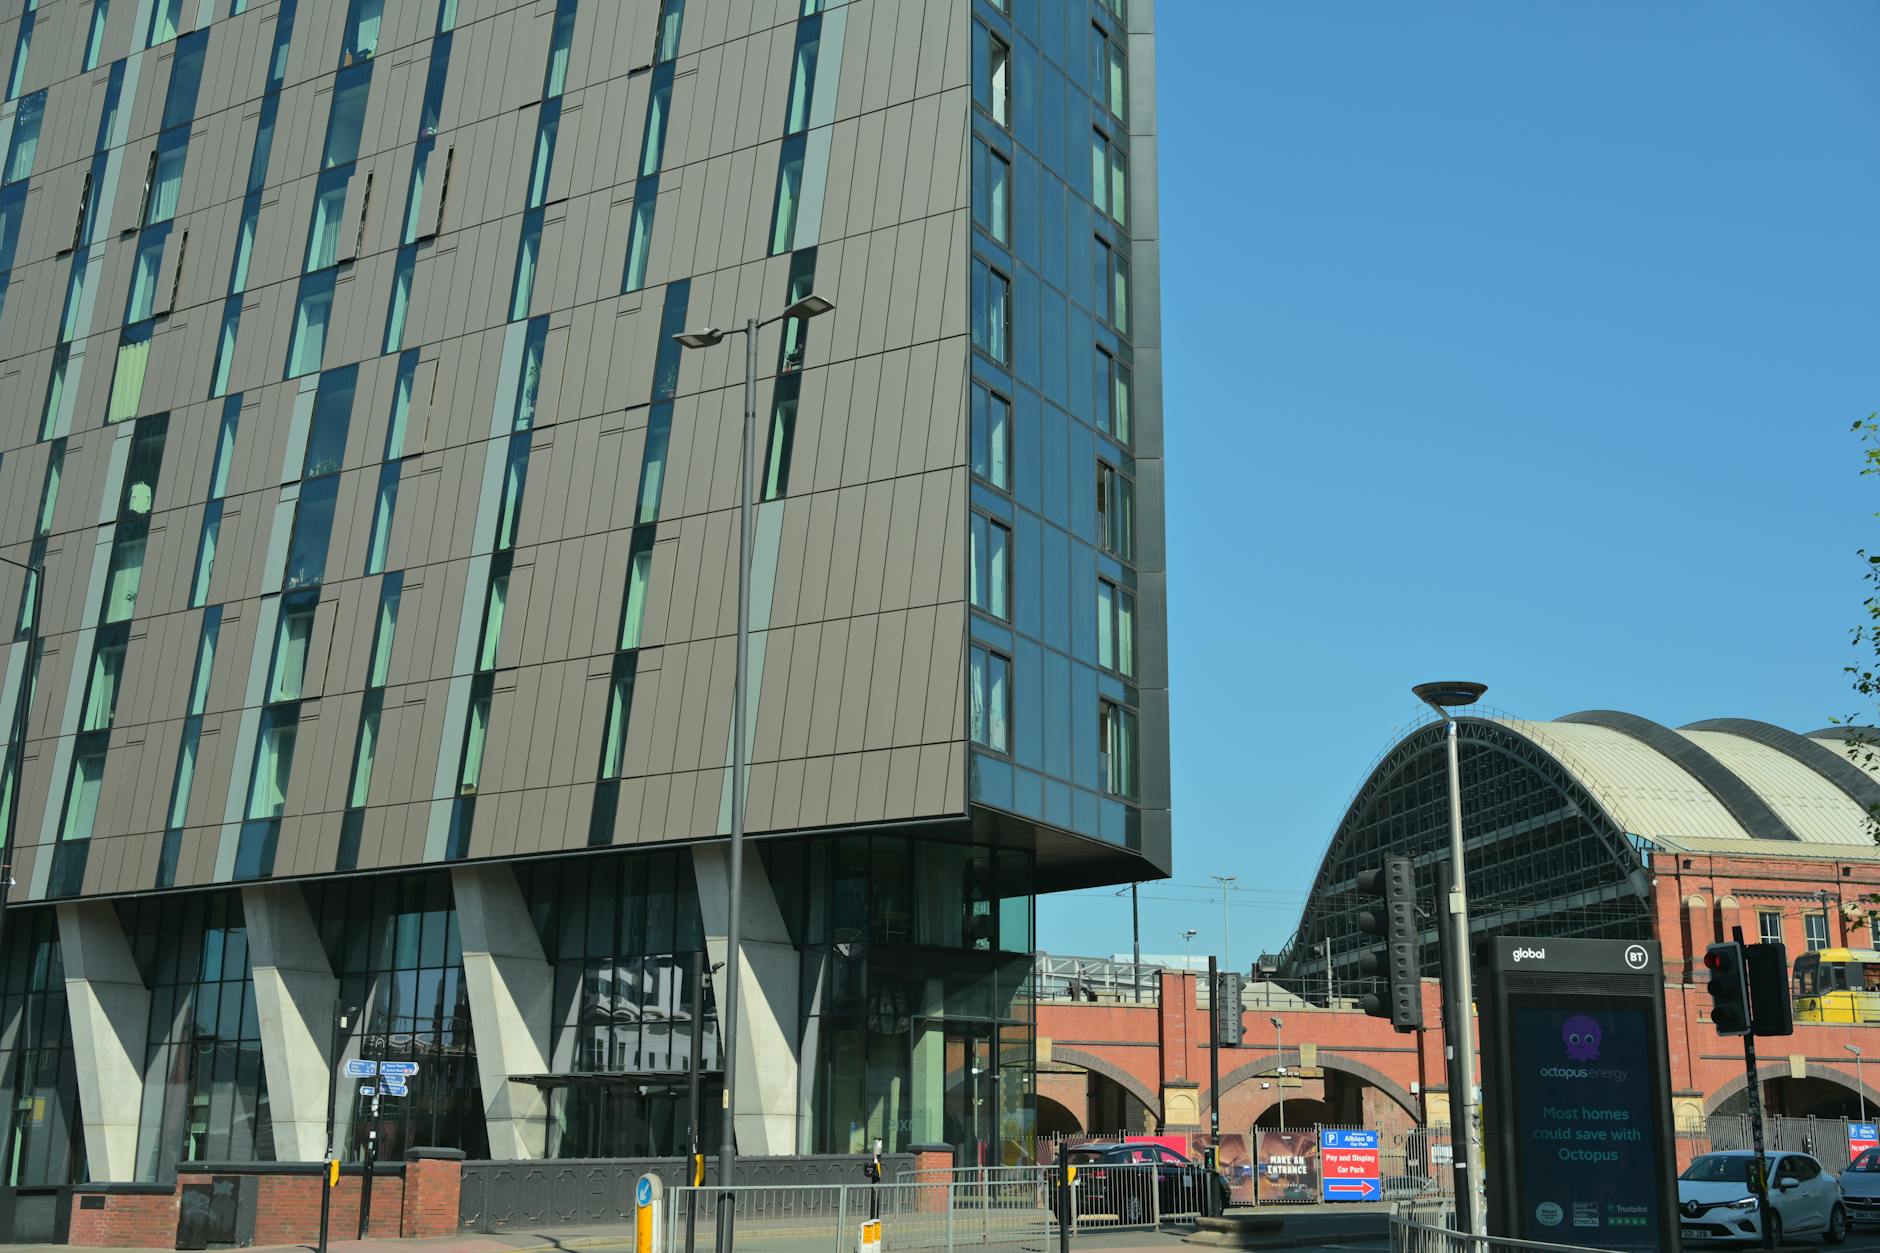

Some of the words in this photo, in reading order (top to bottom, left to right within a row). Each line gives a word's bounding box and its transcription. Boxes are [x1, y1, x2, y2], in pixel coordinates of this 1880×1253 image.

[1512, 947, 1545, 962] global
[1630, 952, 1643, 962] BT
[1540, 1067, 1588, 1079] octopus
[1589, 1068, 1628, 1081] energy
[1543, 1107, 1578, 1120] Most
[1582, 1107, 1629, 1120] homes
[1533, 1127, 1571, 1140] could
[1576, 1130, 1607, 1140] save
[1611, 1128, 1641, 1141] with
[1270, 1156, 1292, 1164] MAKE
[1294, 1156, 1304, 1164] AN
[1326, 1154, 1338, 1162] Pay
[1352, 1154, 1375, 1163] Display
[1558, 1148, 1618, 1163] Octopus
[1267, 1165, 1308, 1174] ENTRANCE
[1616, 1204, 1648, 1214] Trustpilot
